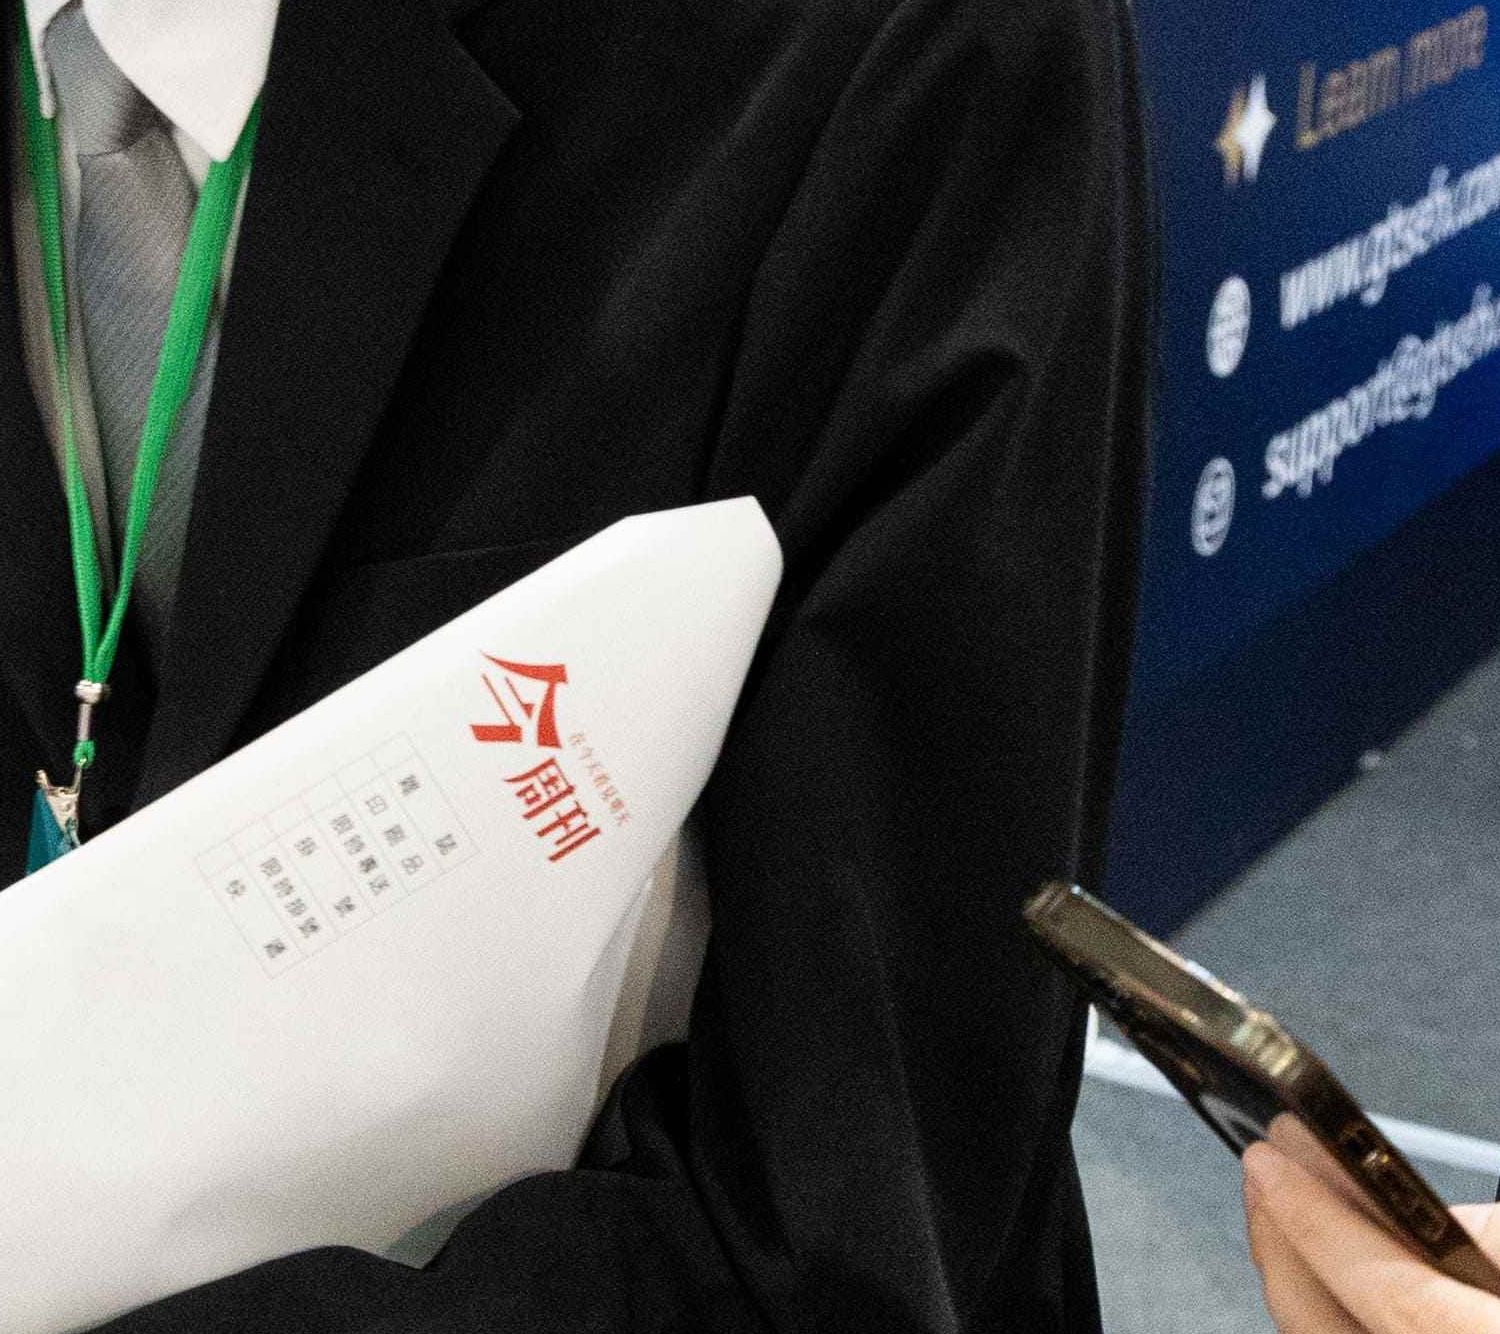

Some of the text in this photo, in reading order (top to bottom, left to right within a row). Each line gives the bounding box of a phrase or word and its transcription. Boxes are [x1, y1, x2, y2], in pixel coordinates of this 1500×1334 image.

[1295, 3, 1488, 149] Learn more
[468, 650, 602, 863] 今周刊
